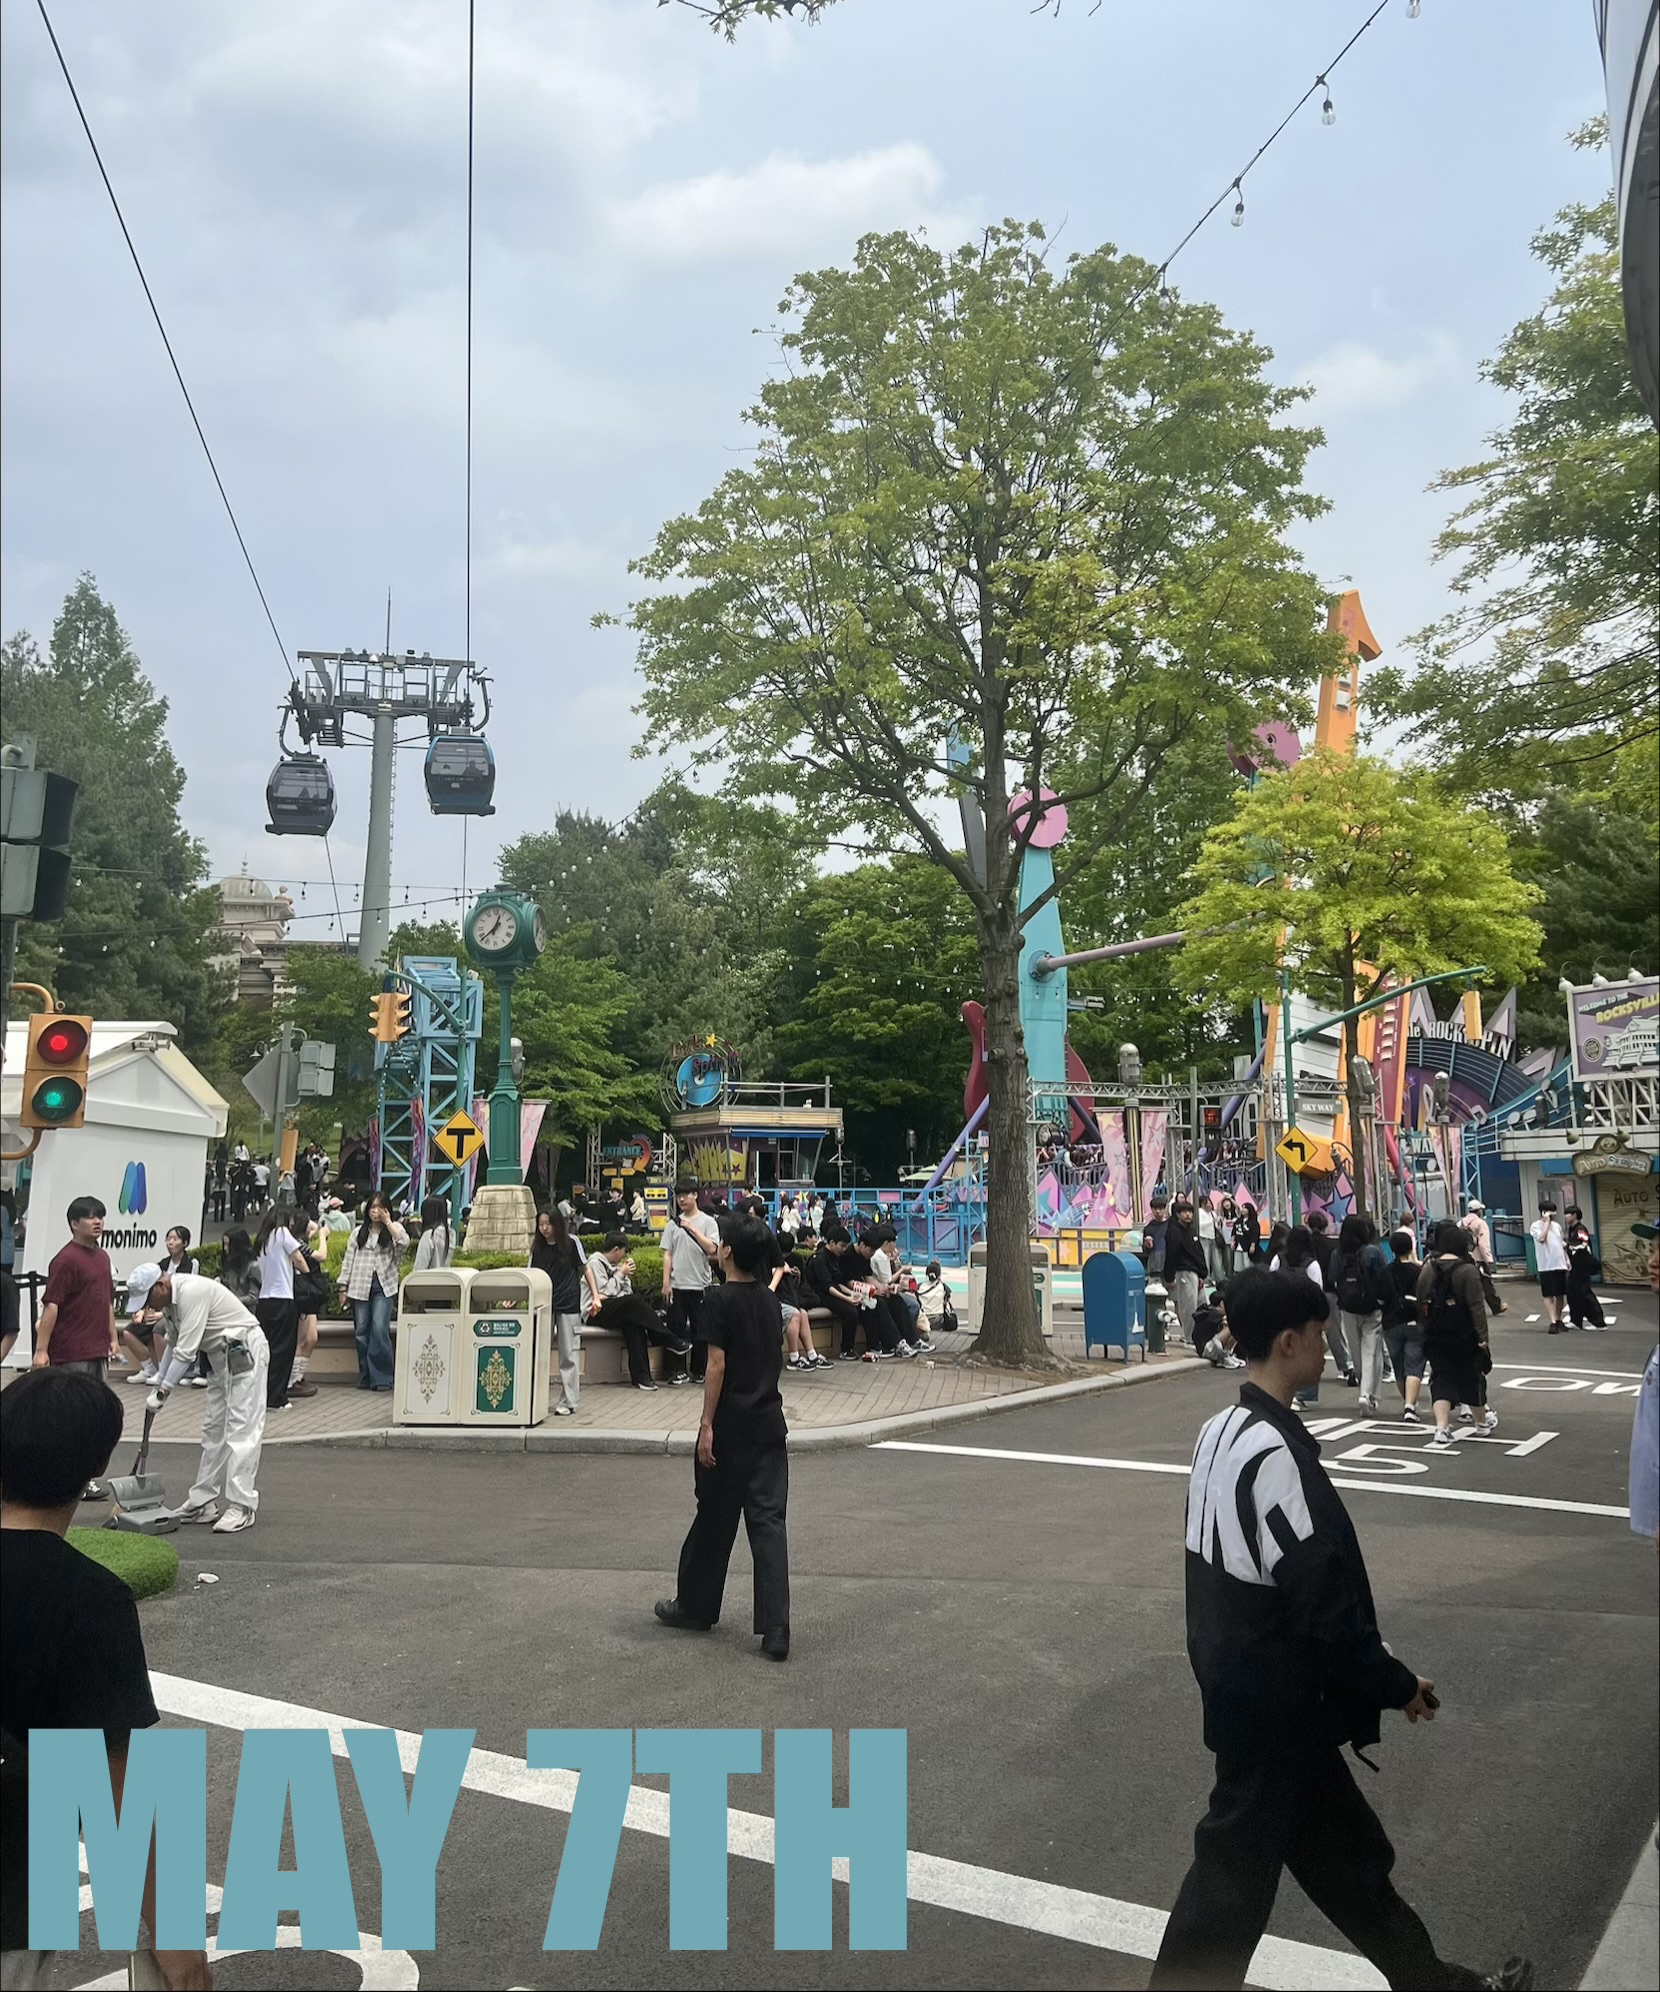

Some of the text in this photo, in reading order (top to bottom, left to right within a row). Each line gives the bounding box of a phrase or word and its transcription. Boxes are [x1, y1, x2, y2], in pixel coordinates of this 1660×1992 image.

[1578, 991, 1629, 1012] WELCOME TO THE
[1428, 1020, 1463, 1044] ROCK
[1302, 1103, 1335, 1112] SKY WAY
[603, 1145, 642, 1157] ENTRANCE
[101, 1221, 158, 1249] monimo
